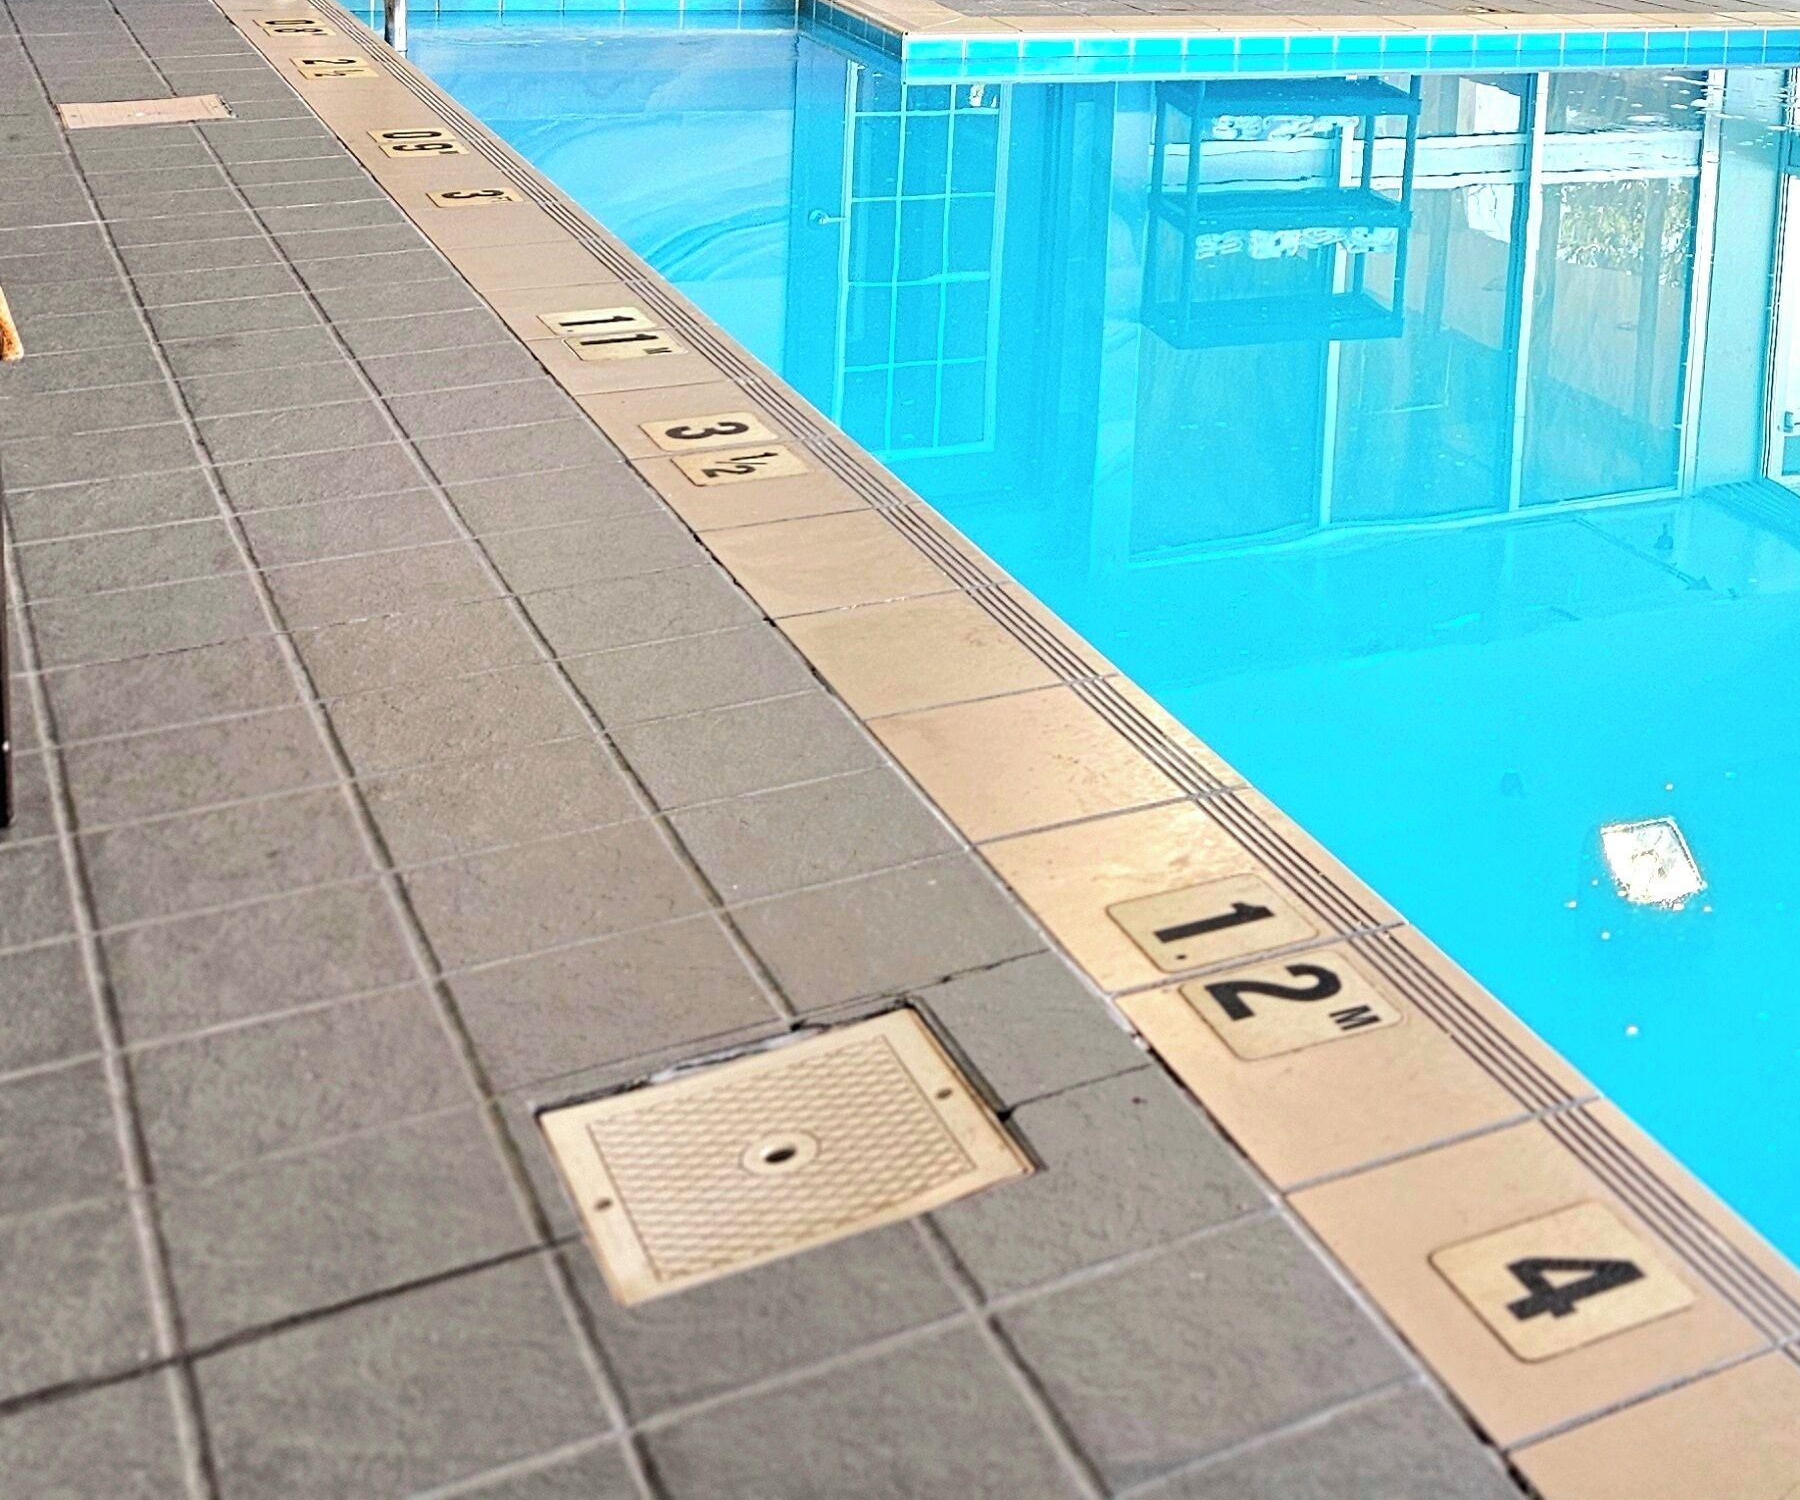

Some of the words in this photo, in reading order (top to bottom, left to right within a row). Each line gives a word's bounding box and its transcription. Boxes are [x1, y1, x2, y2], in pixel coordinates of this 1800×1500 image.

[664, 421, 749, 440] 3
[1328, 1003, 1382, 1032] M
[1505, 1256, 1647, 1322] 4
